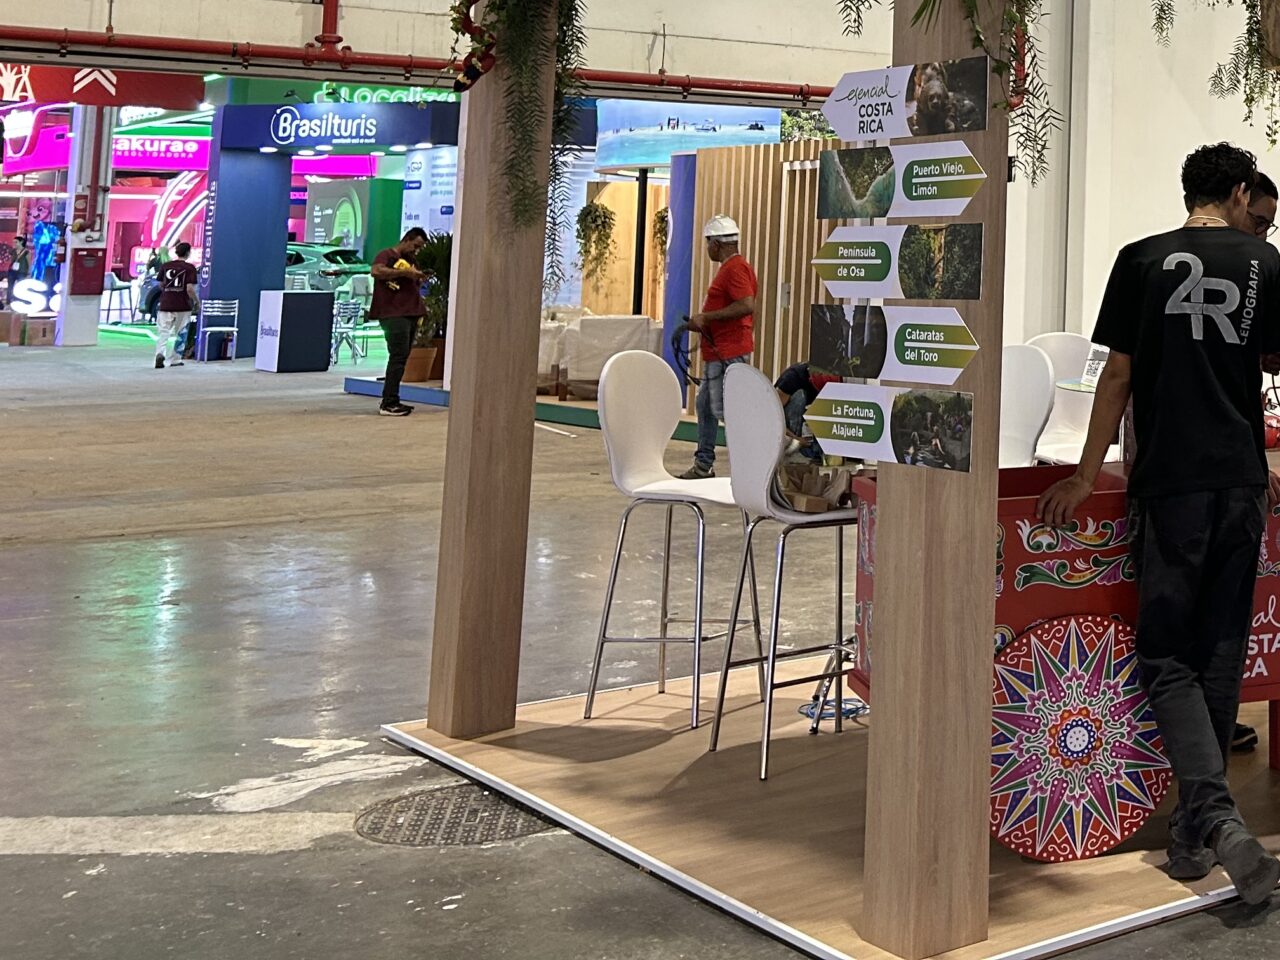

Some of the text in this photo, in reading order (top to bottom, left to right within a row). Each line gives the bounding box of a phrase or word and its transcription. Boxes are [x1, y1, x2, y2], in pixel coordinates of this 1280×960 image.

[835, 75, 898, 106] esencial
[858, 102, 893, 118] COSTA
[278, 111, 377, 139] Brasilturis
[858, 119, 884, 134] RICA
[913, 162, 965, 176] Puerto Viejo,
[912, 183, 937, 196] Limón
[838, 246, 876, 257] Península
[837, 266, 865, 277] de Osa
[905, 328, 944, 341] Cataratas
[904, 349, 938, 362] del Toro
[832, 404, 876, 419] La Fortuna,
[831, 424, 863, 438] Alajuela
